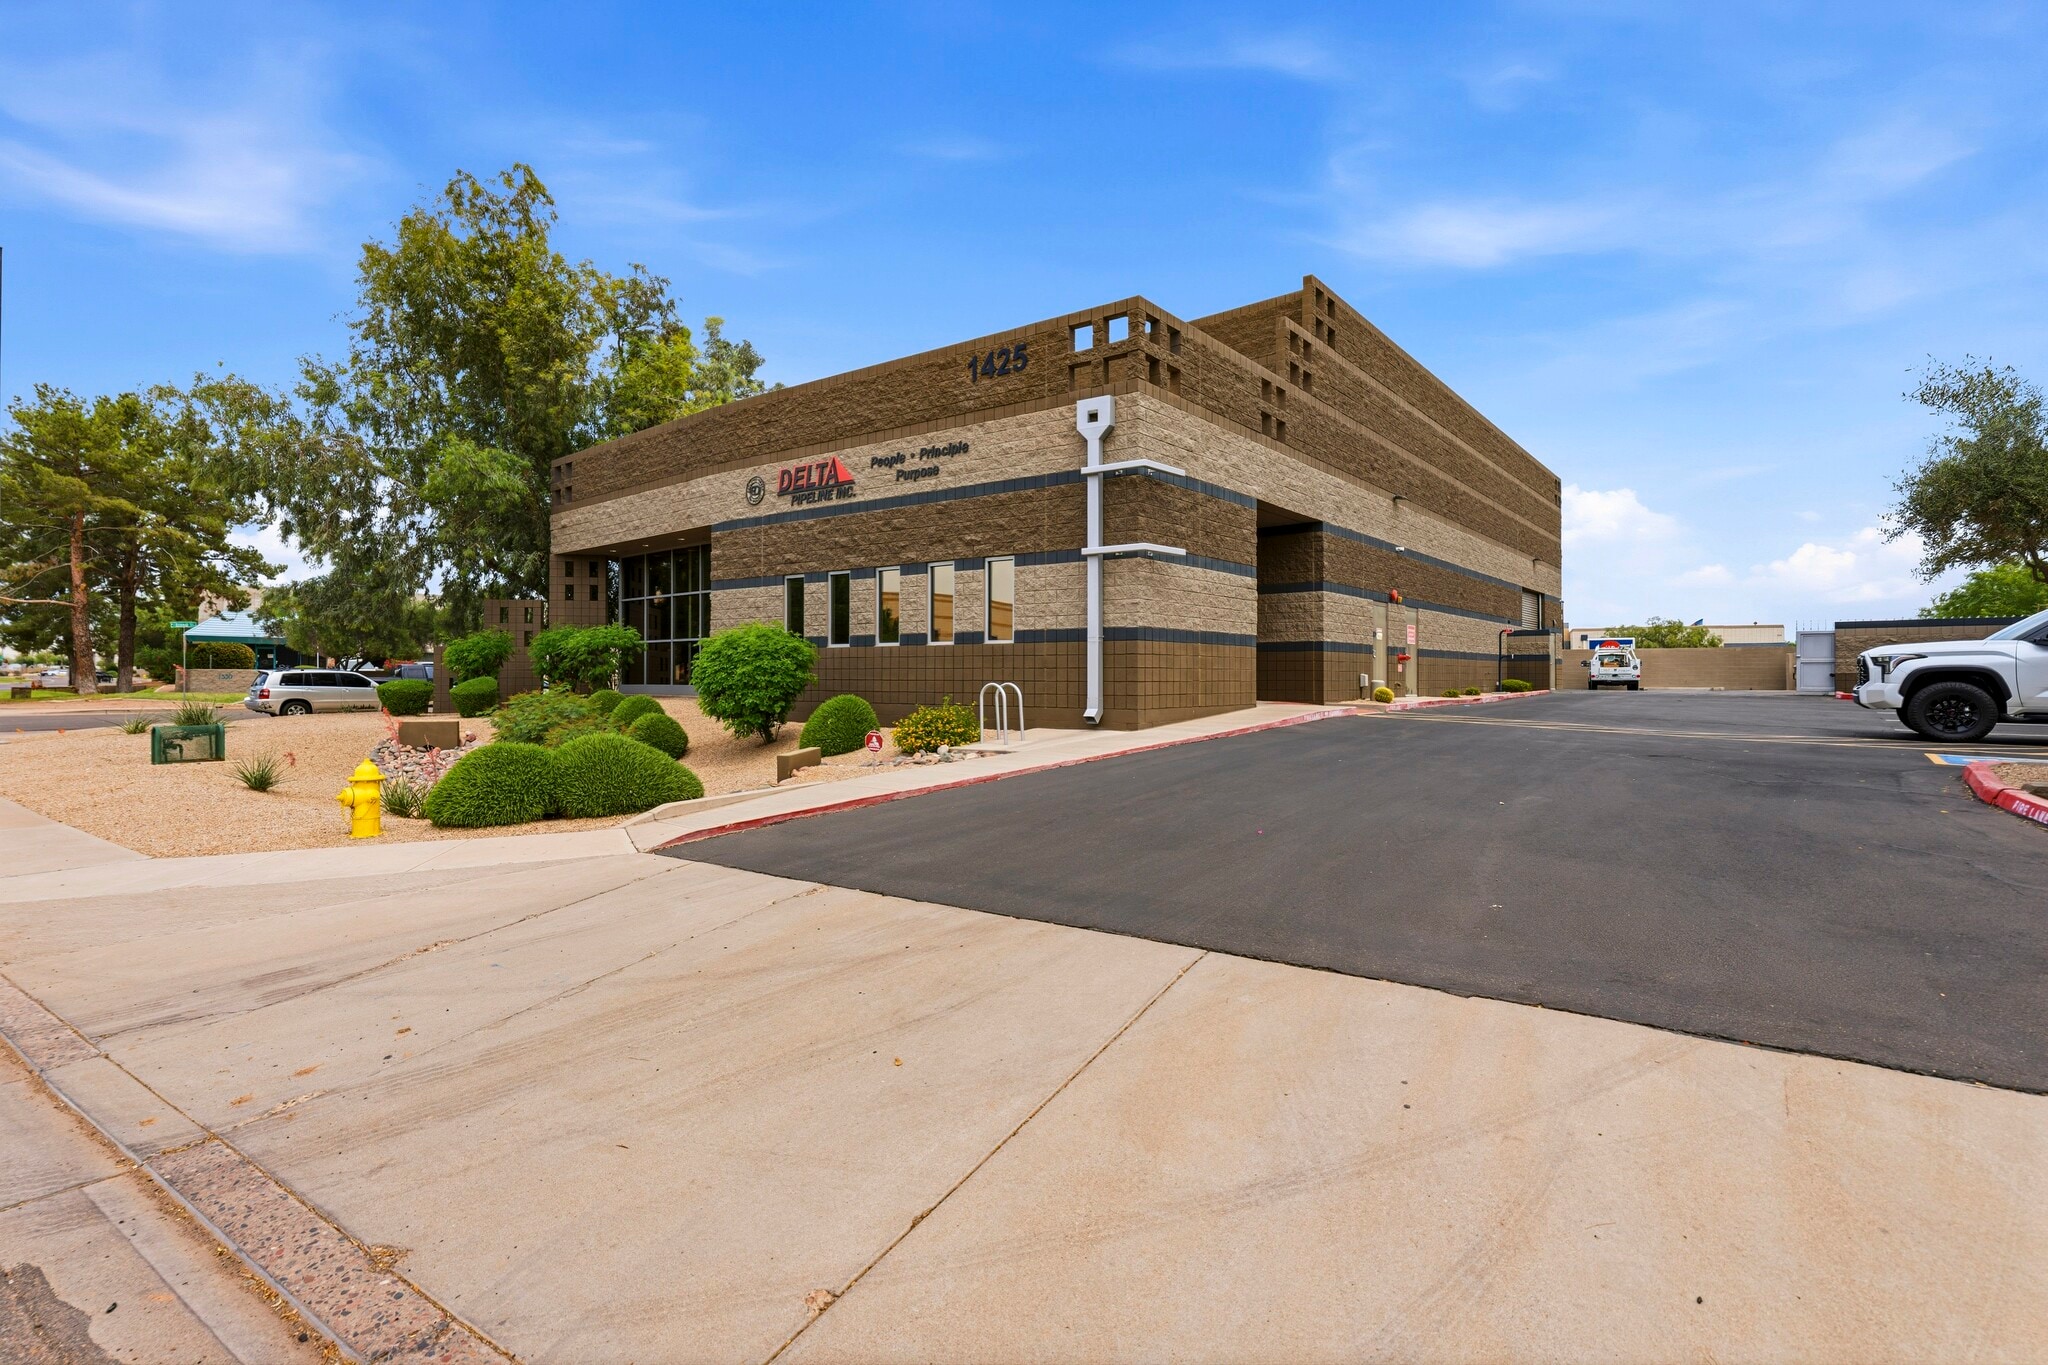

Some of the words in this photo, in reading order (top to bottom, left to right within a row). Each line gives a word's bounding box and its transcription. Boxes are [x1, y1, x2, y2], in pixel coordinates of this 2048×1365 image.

[968, 342, 1028, 382] 1425
[870, 452, 906, 469] People
[919, 441, 969, 460] Principle
[778, 456, 842, 494] DELTA
[896, 465, 940, 482] Purpose
[790, 488, 834, 506] PIPELINE
[835, 486, 857, 500] INC.
[2011, 800, 2030, 816] FIRE
